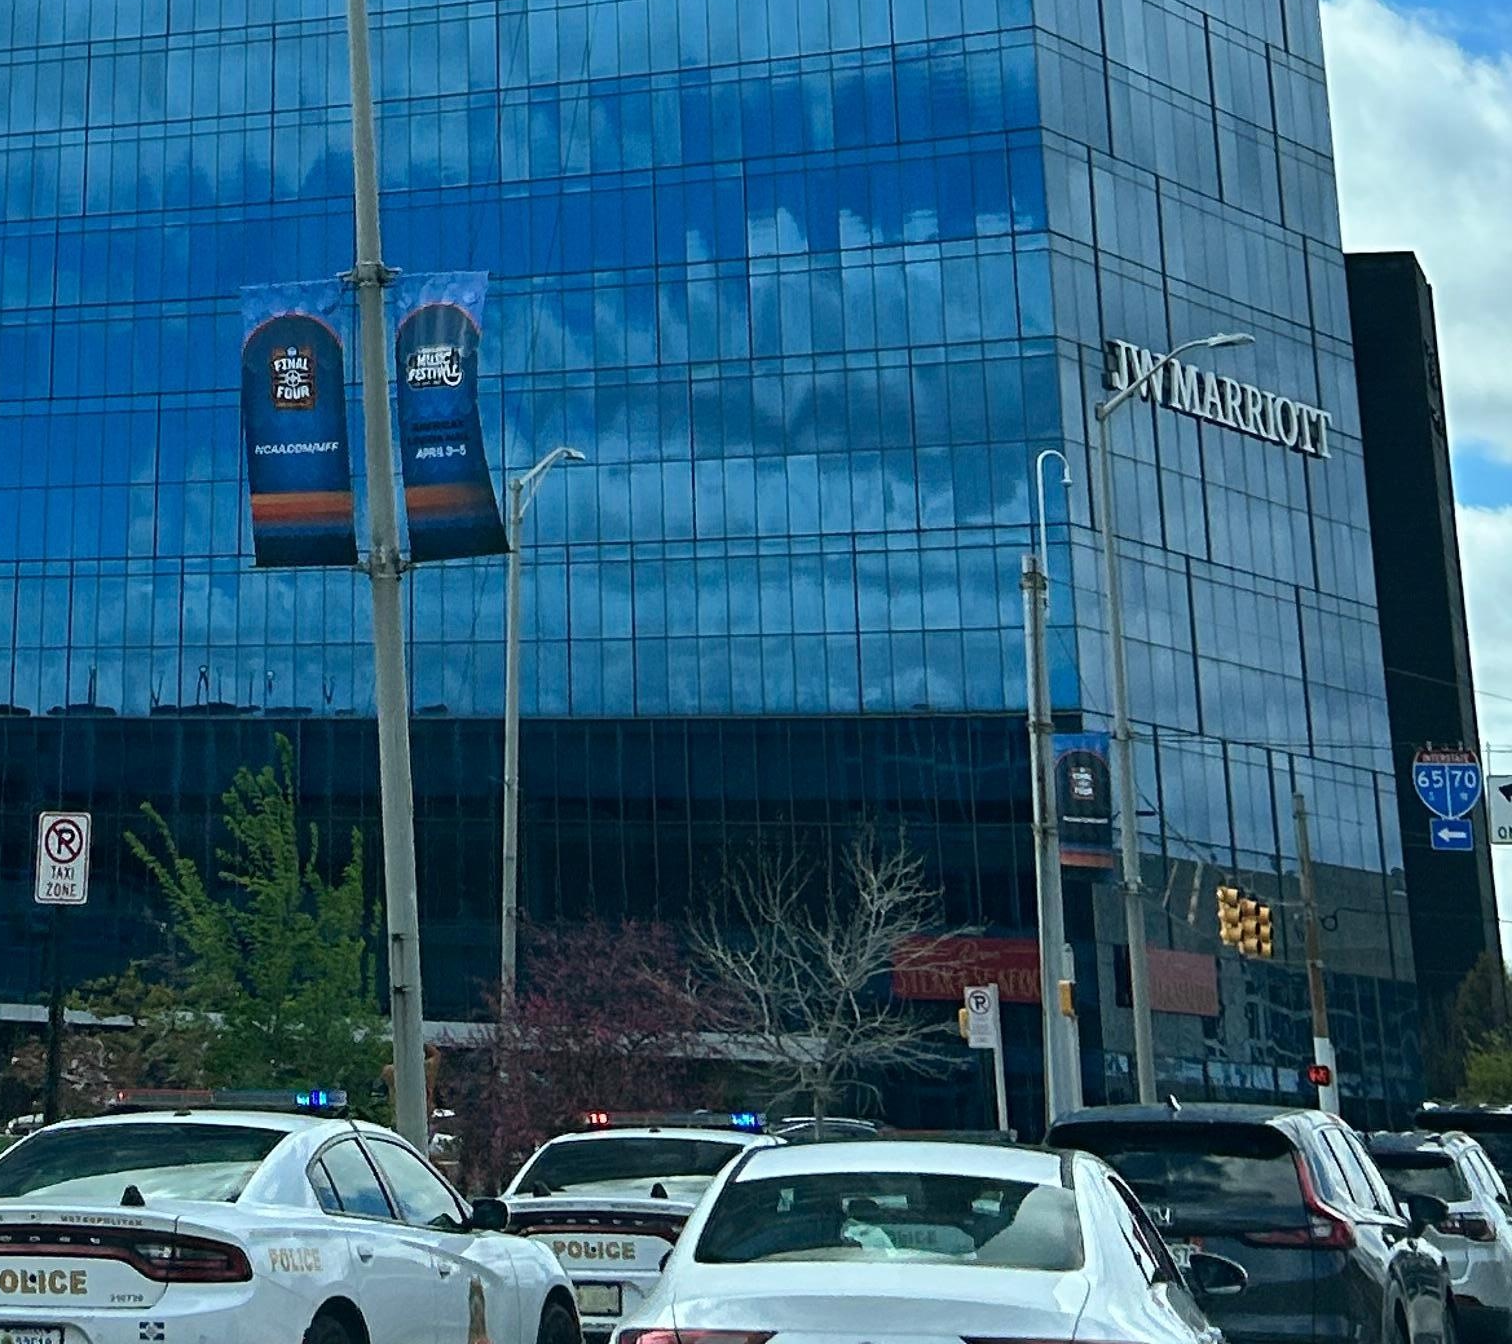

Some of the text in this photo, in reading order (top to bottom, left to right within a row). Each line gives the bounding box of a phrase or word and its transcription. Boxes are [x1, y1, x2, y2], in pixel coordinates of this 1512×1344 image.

[1111, 340, 1332, 460] JW MARRIOTT
[1417, 770, 1477, 789] 65 70
[51, 865, 76, 880] TAXI
[46, 883, 76, 897] ZONE
[269, 1247, 321, 1272] POLICE
[553, 1240, 636, 1260] POLICE
